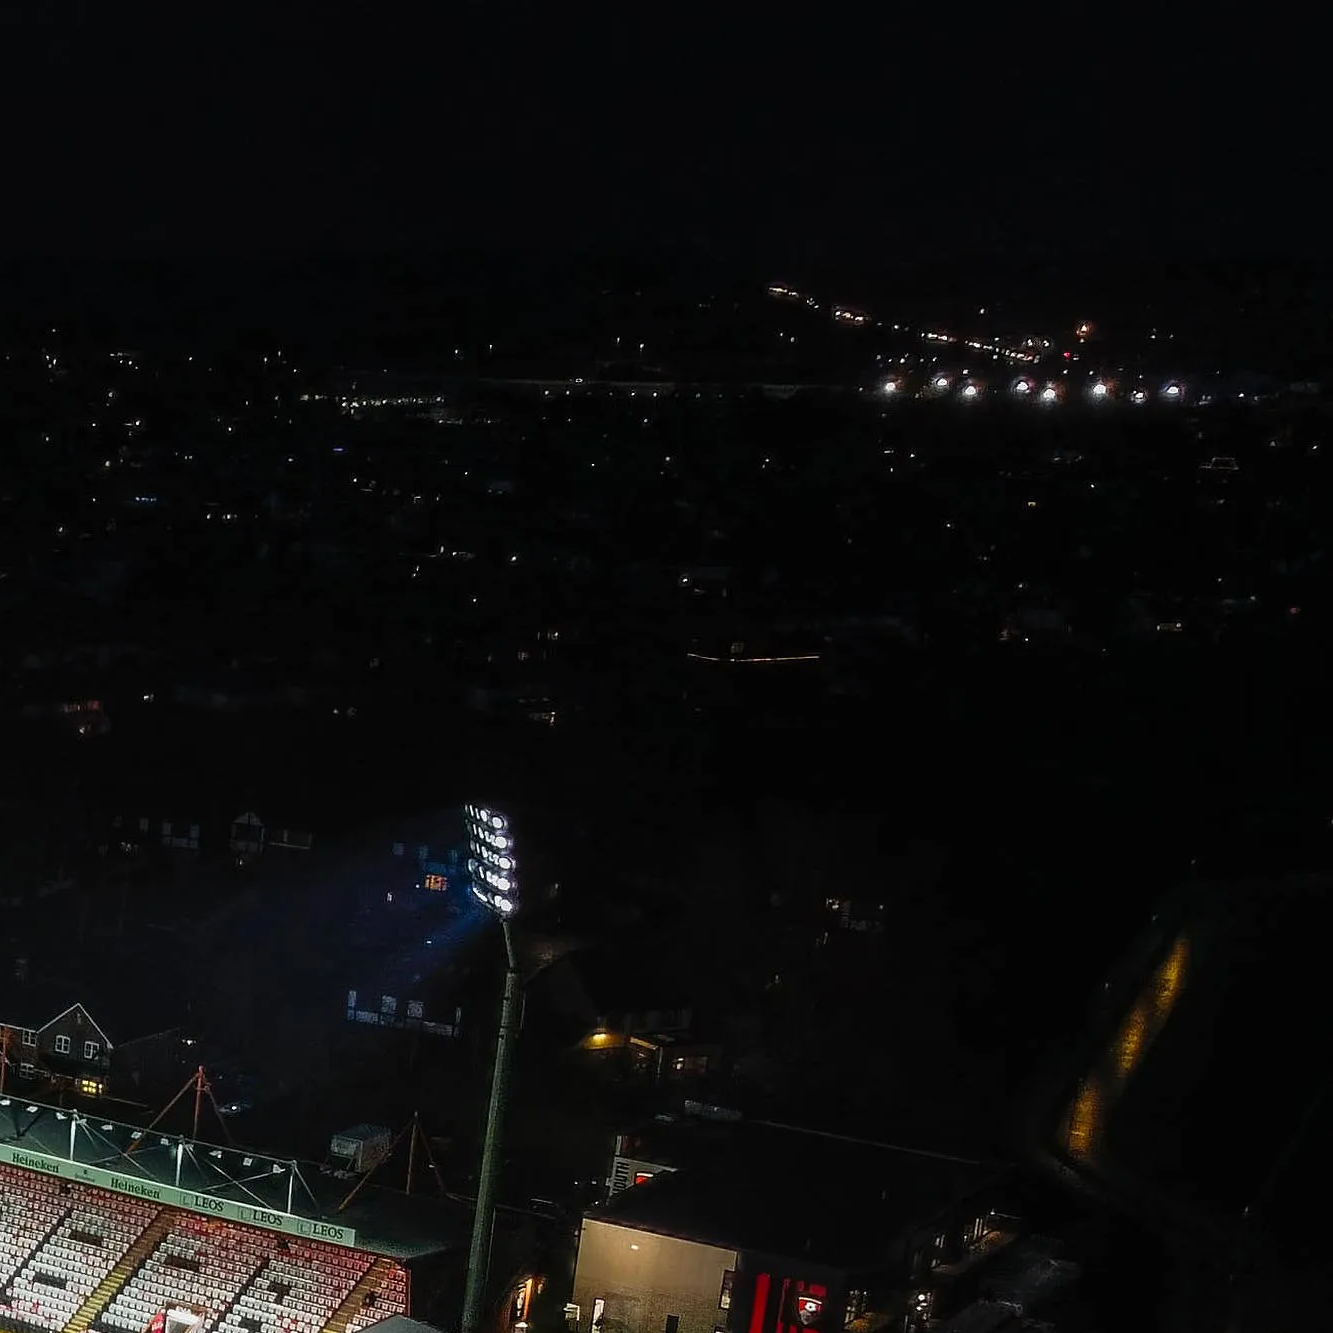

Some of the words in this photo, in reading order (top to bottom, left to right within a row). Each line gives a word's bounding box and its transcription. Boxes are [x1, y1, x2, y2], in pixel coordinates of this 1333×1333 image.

[12, 1152, 59, 1174] Heineken
[110, 1177, 161, 1199] Heineken
[194, 1195, 224, 1212] LEOS
[253, 1210, 283, 1226] LEOS
[313, 1224, 344, 1240] LEOS
